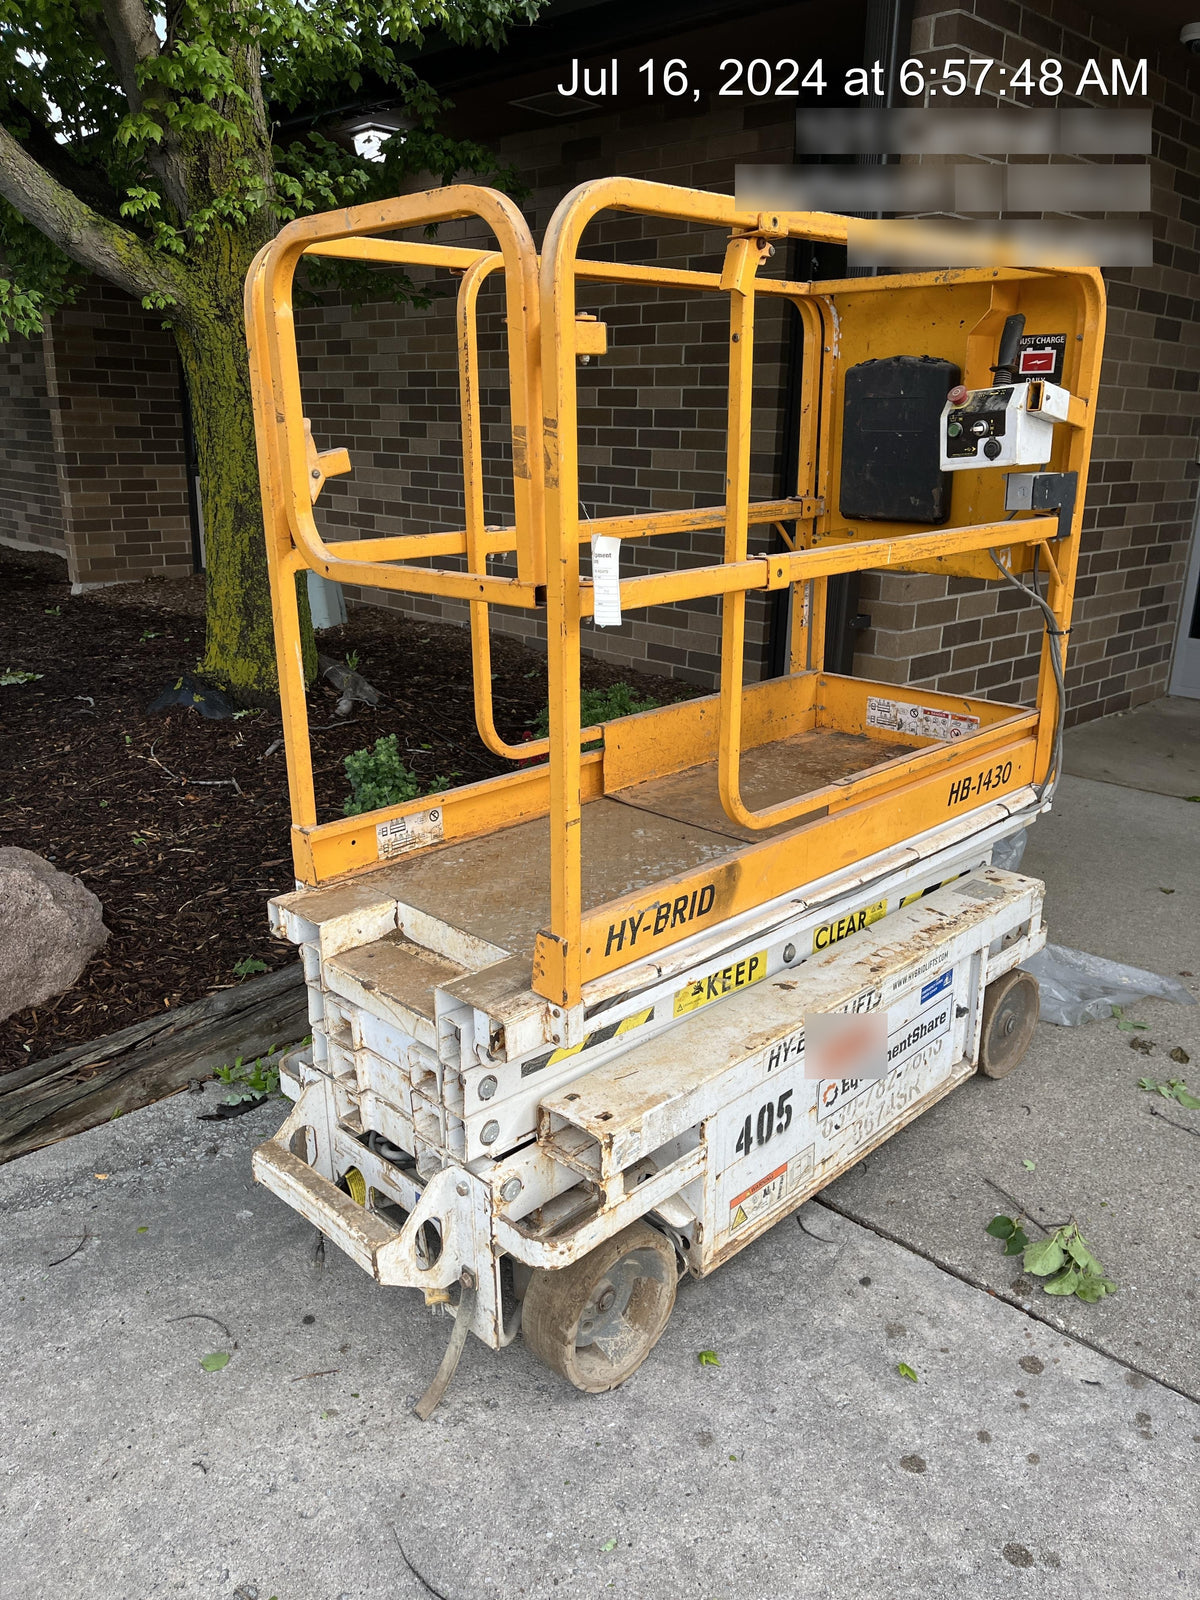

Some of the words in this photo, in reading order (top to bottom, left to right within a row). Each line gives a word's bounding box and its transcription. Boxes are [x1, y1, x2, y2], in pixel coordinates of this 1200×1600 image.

[1036, 335, 1065, 345] CHARGE
[947, 761, 1013, 806] HB-1430
[604, 884, 716, 957] HY-BRID
[706, 955, 760, 1000] KEEP
[814, 910, 867, 950] CLEAR
[735, 1088, 794, 1156] 405
